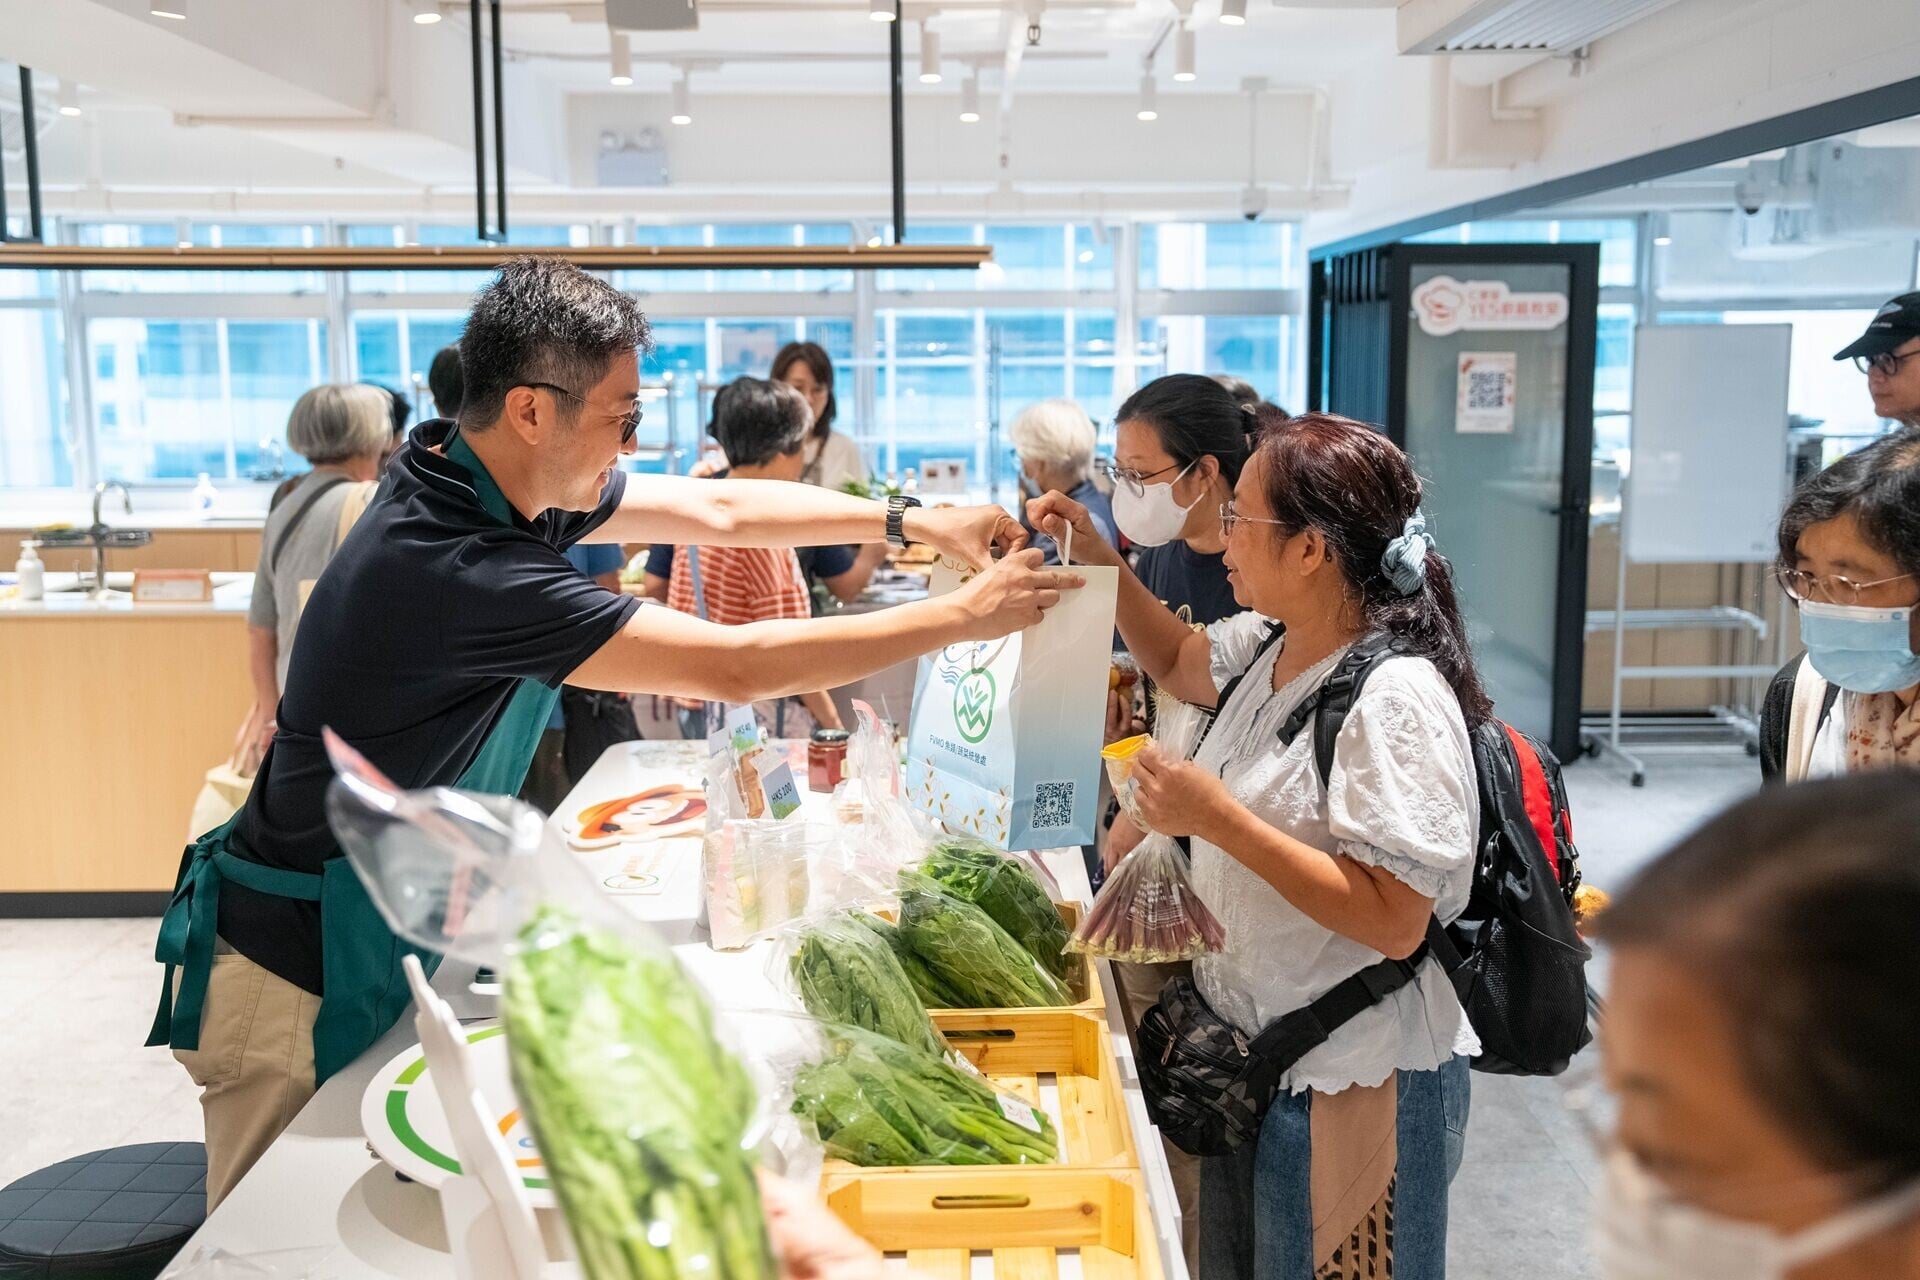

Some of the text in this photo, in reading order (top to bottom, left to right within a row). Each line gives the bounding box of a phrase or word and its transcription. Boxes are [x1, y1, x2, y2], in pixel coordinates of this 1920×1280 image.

[929, 734, 945, 748] FVMO
[771, 781, 792, 804] HK$ 100
